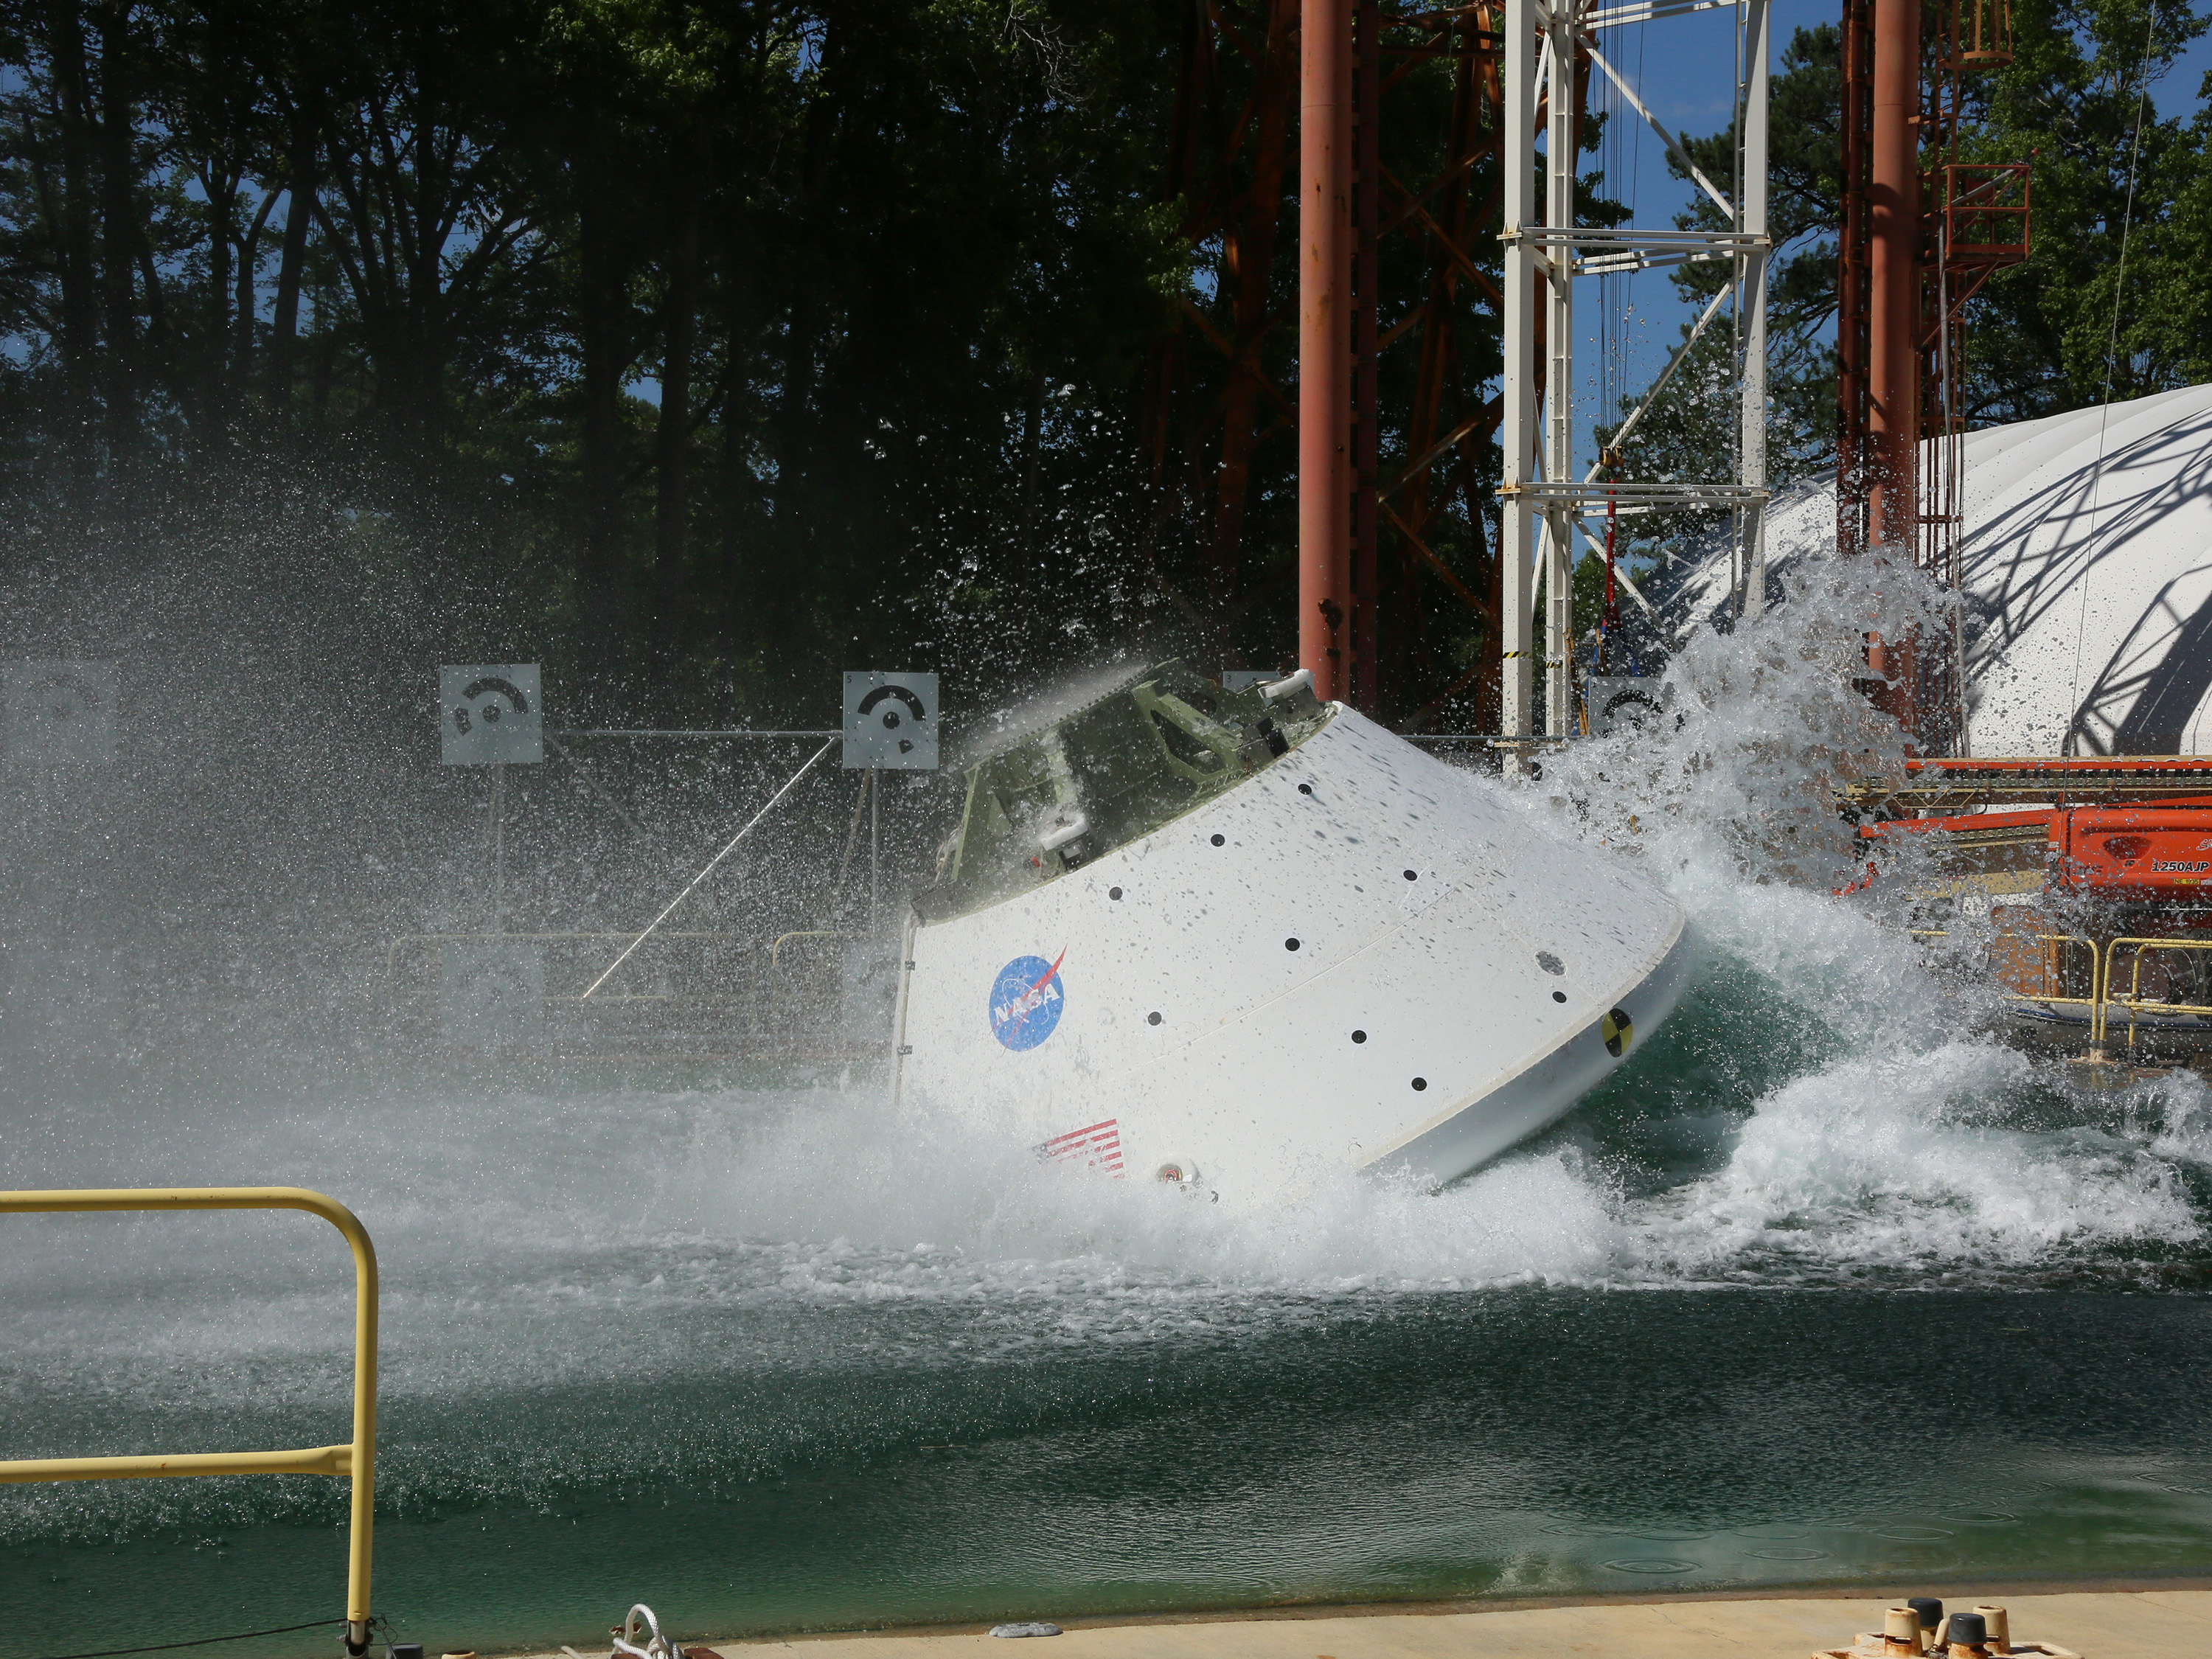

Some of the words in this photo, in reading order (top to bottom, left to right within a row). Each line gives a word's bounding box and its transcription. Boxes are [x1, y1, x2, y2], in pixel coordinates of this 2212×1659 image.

[1227, 675, 1231, 683] 3
[2151, 860, 2210, 872] 1250AJP
[994, 983, 1060, 1026] NASA
